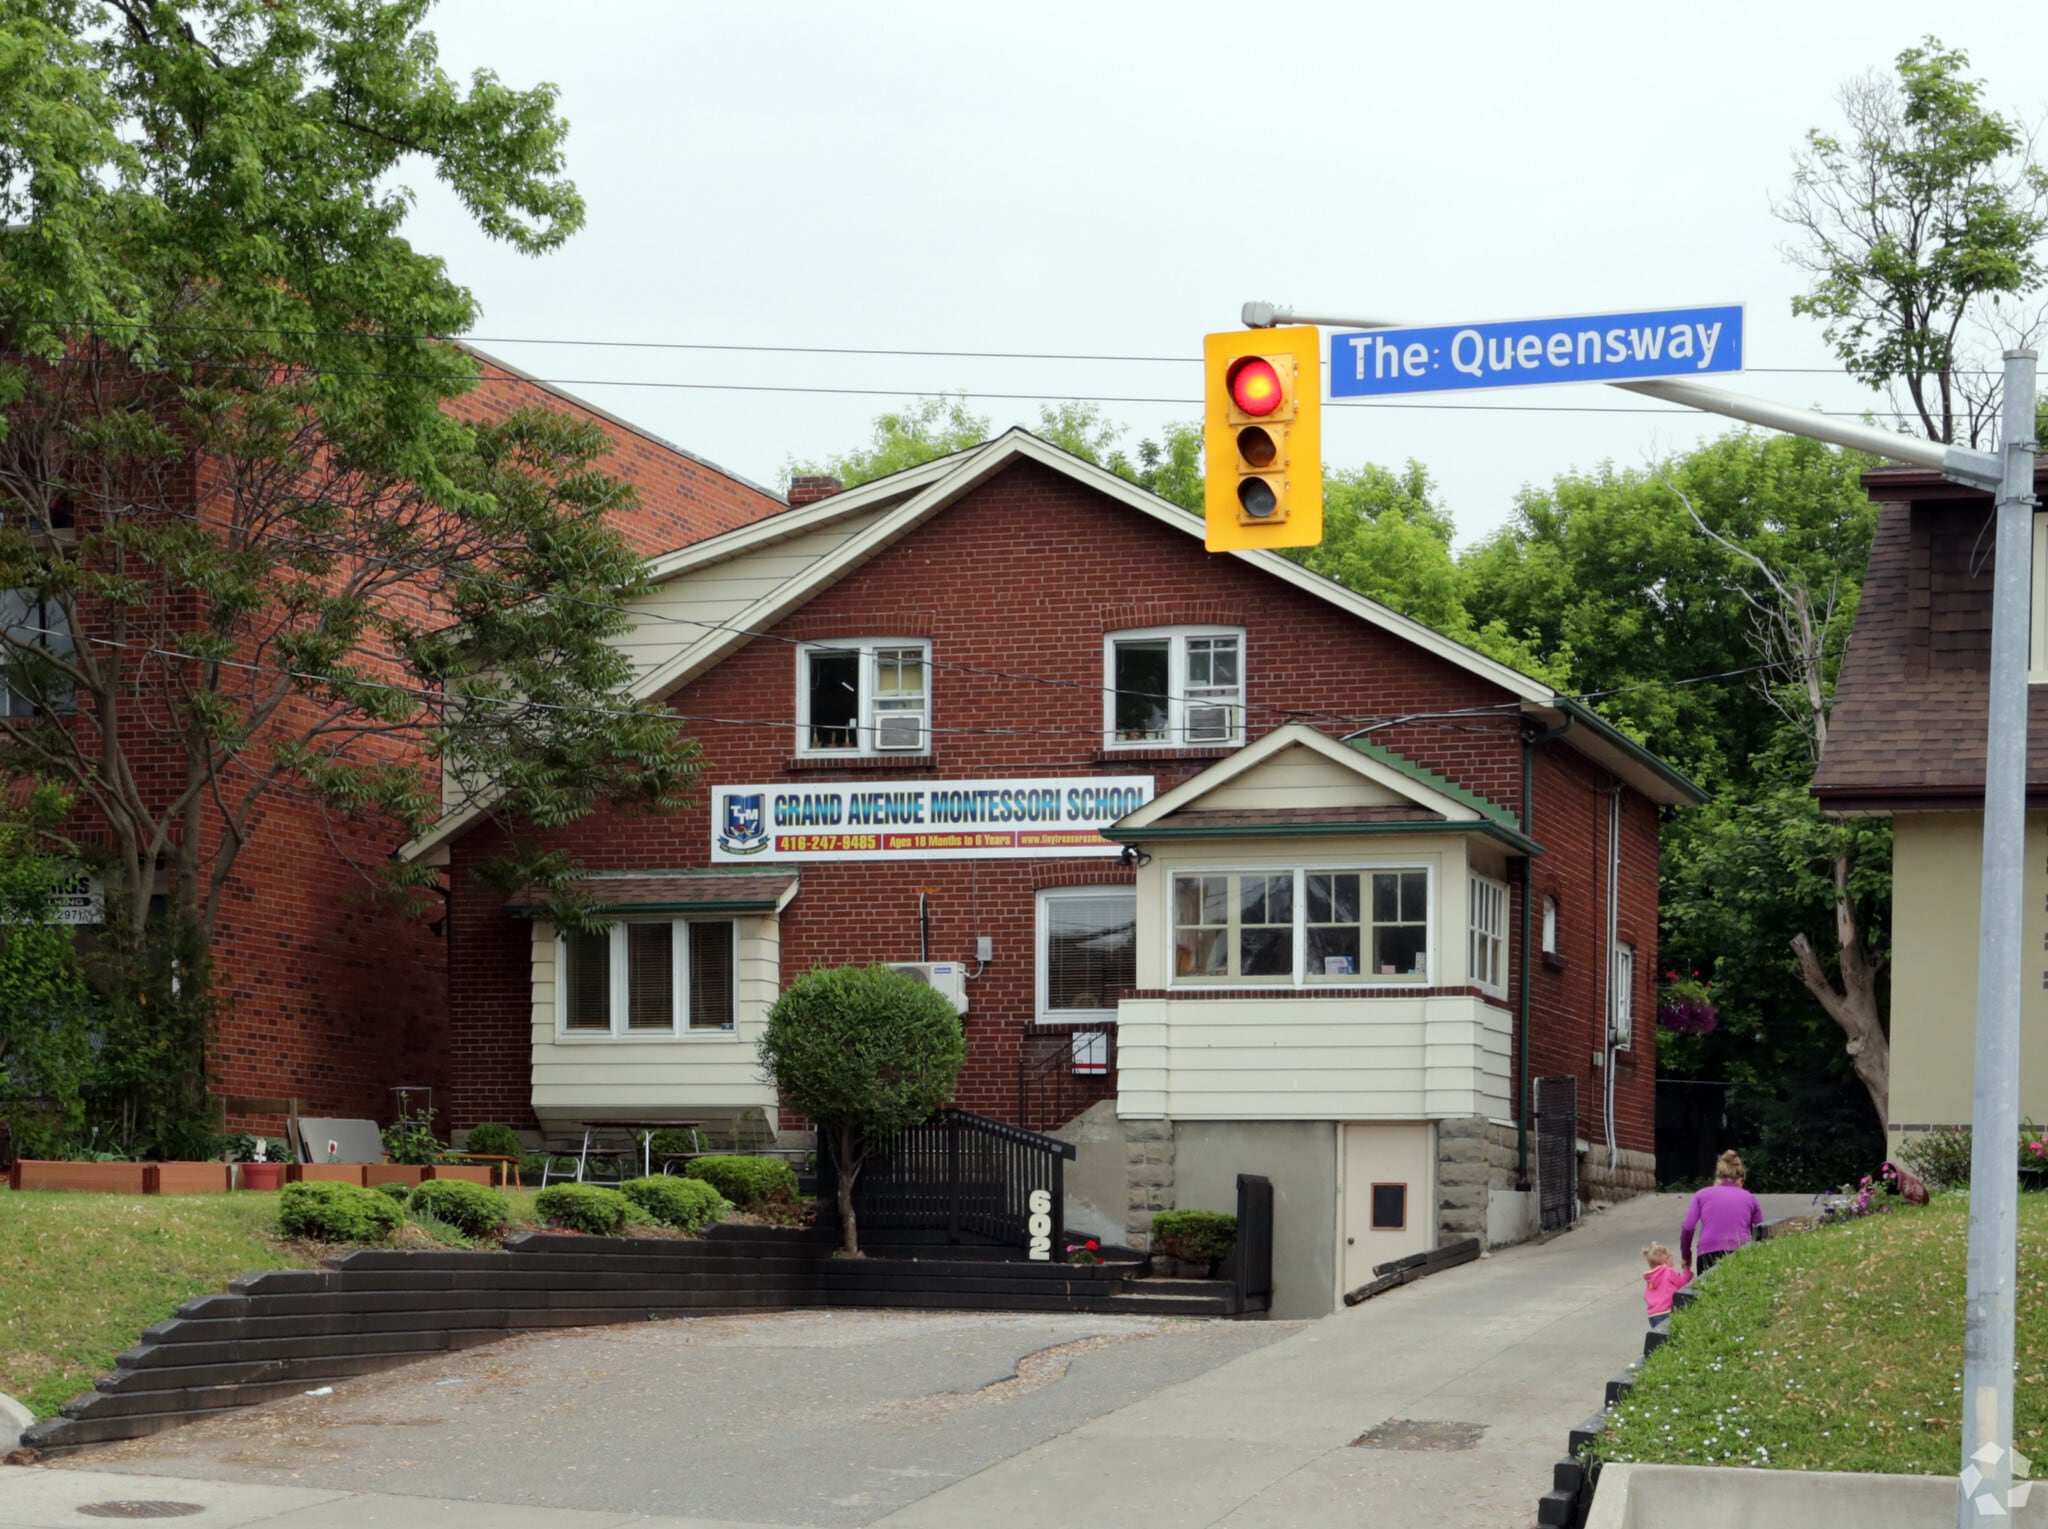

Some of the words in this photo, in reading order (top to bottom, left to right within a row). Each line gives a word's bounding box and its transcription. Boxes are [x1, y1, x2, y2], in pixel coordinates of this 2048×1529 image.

[1348, 336, 1429, 380] The
[1450, 322, 1723, 377] Queensway
[774, 794, 842, 827] GRAND
[847, 792, 925, 825] AVENUE
[930, 788, 1061, 823] MONTESSORI
[780, 835, 876, 851] 416-247-9485
[889, 835, 912, 848] Ages
[915, 835, 926, 847] 18
[928, 835, 962, 847] Months
[964, 835, 973, 846] to
[984, 833, 1011, 846] Years
[1028, 1189, 1051, 1260] 602
